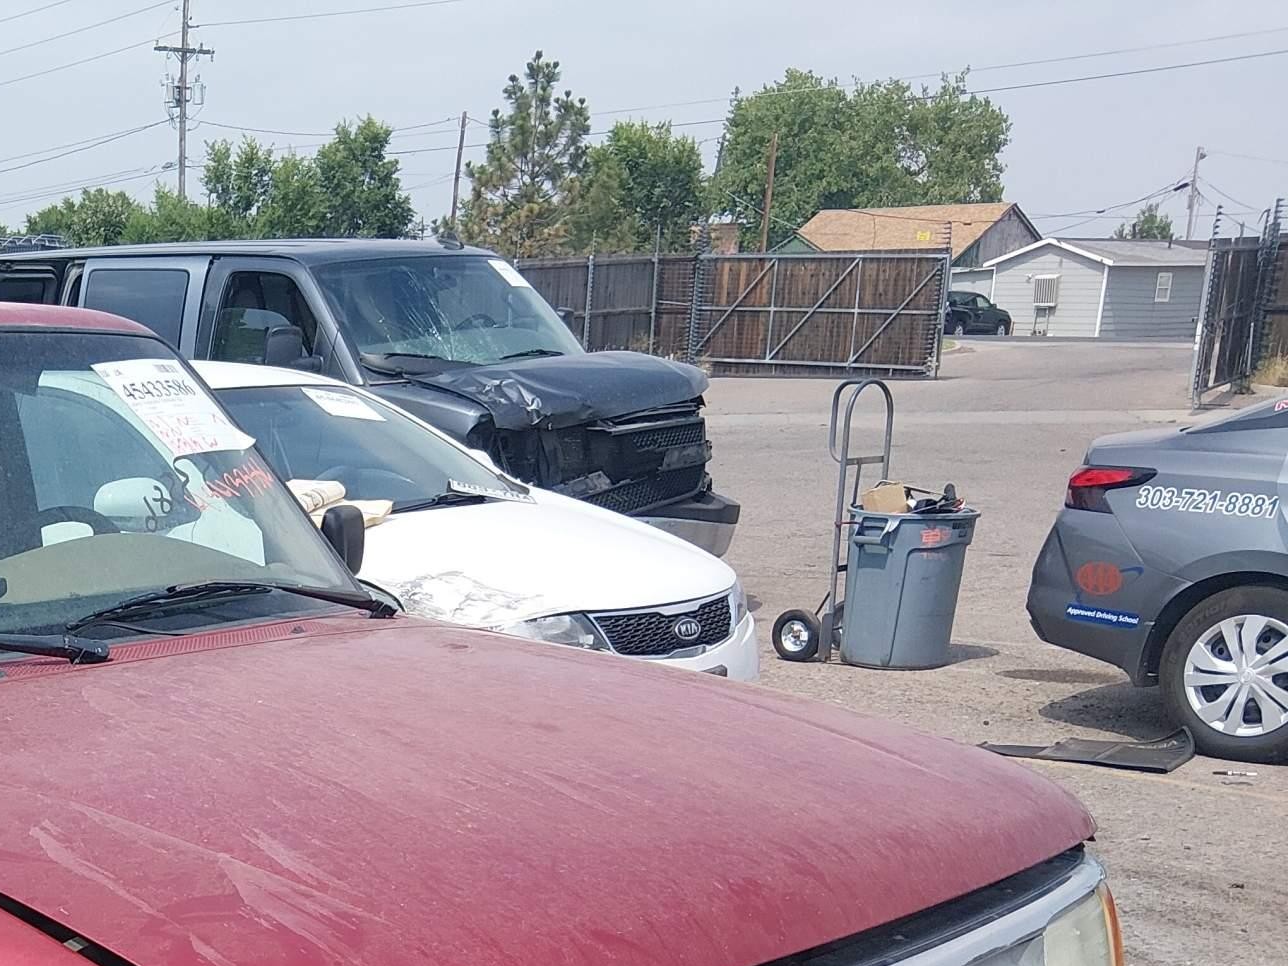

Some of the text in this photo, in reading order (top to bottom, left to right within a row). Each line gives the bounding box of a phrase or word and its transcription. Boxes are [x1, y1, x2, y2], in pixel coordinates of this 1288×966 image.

[122, 378, 197, 401] 45433586
[1136, 485, 1279, 518] 303-721-8881
[1066, 606, 1140, 625] Approved Driving School
[680, 622, 699, 636] KIA
